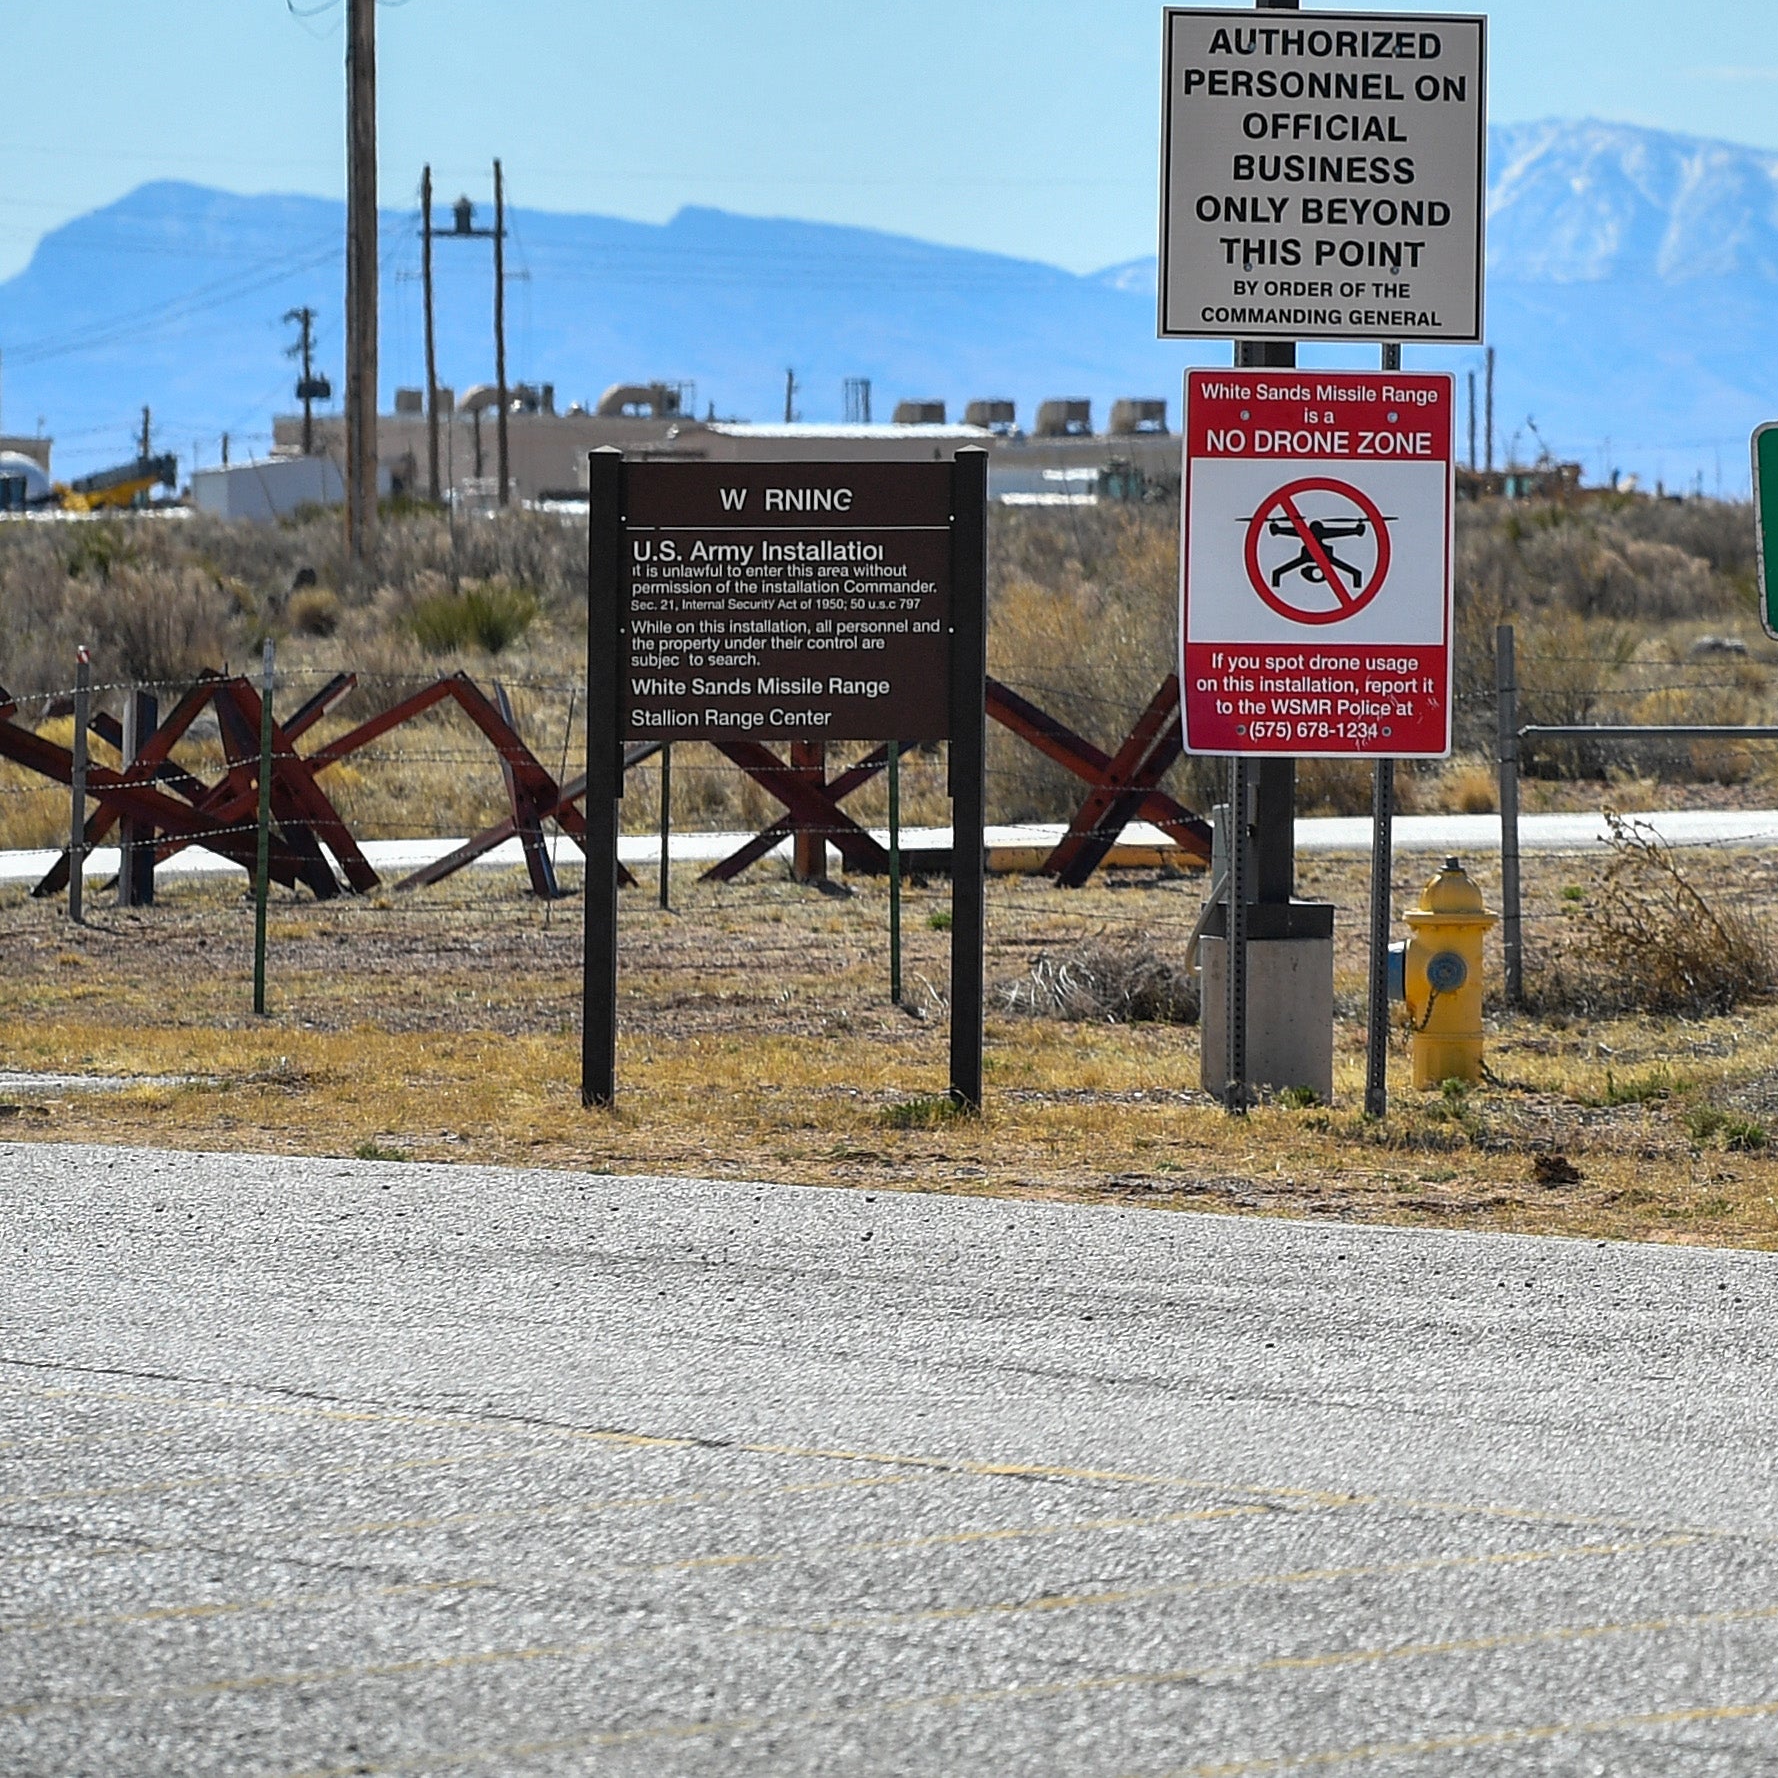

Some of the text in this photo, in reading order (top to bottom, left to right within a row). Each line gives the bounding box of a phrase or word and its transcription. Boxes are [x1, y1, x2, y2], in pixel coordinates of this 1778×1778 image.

[1208, 28, 1441, 60] AUTHORIZED
[1184, 69, 1466, 102] PERSONNEL ON
[1242, 112, 1408, 143] OFFICIAL
[1233, 154, 1415, 185] BUSINESS
[1196, 195, 1451, 227] ONLY BEYOND
[1219, 237, 1426, 270] THIS POINT
[1233, 280, 1411, 299] BY ORDER OF THE
[1201, 306, 1443, 327] COMMANDING GENERAL
[1201, 382, 1438, 407] White Sands Missile Range
[1304, 407, 1335, 424] is a
[1207, 429, 1432, 455] NO DRONE ZONE
[633, 540, 684, 563] U.S.
[689, 540, 754, 566] Army
[646, 563, 659, 578] is
[662, 563, 723, 578] unlawful
[726, 564, 743, 578] to
[745, 564, 784, 578] enter
[787, 563, 814, 578] this
[817, 566, 850, 577] area
[852, 563, 908, 577] without
[632, 579, 937, 597] permission of the installation Commander.
[681, 598, 725, 611] Internal
[777, 598, 798, 610] Act
[800, 598, 812, 610] of
[850, 598, 866, 610] 50
[899, 597, 921, 610] 797
[631, 619, 940, 637] While on this installation, all personnel and
[631, 636, 885, 653] the property under their control are
[688, 653, 704, 667] to
[707, 652, 761, 667] search.
[1212, 652, 1419, 675] If you spot drone usage
[631, 677, 890, 698] White Sands Missile Range
[1196, 675, 1434, 698] on this installation, report it
[1215, 698, 1413, 717] to the WSMR Police at
[631, 708, 832, 730] Stallion Range Center
[1249, 721, 1378, 741] (575) 678-1234
